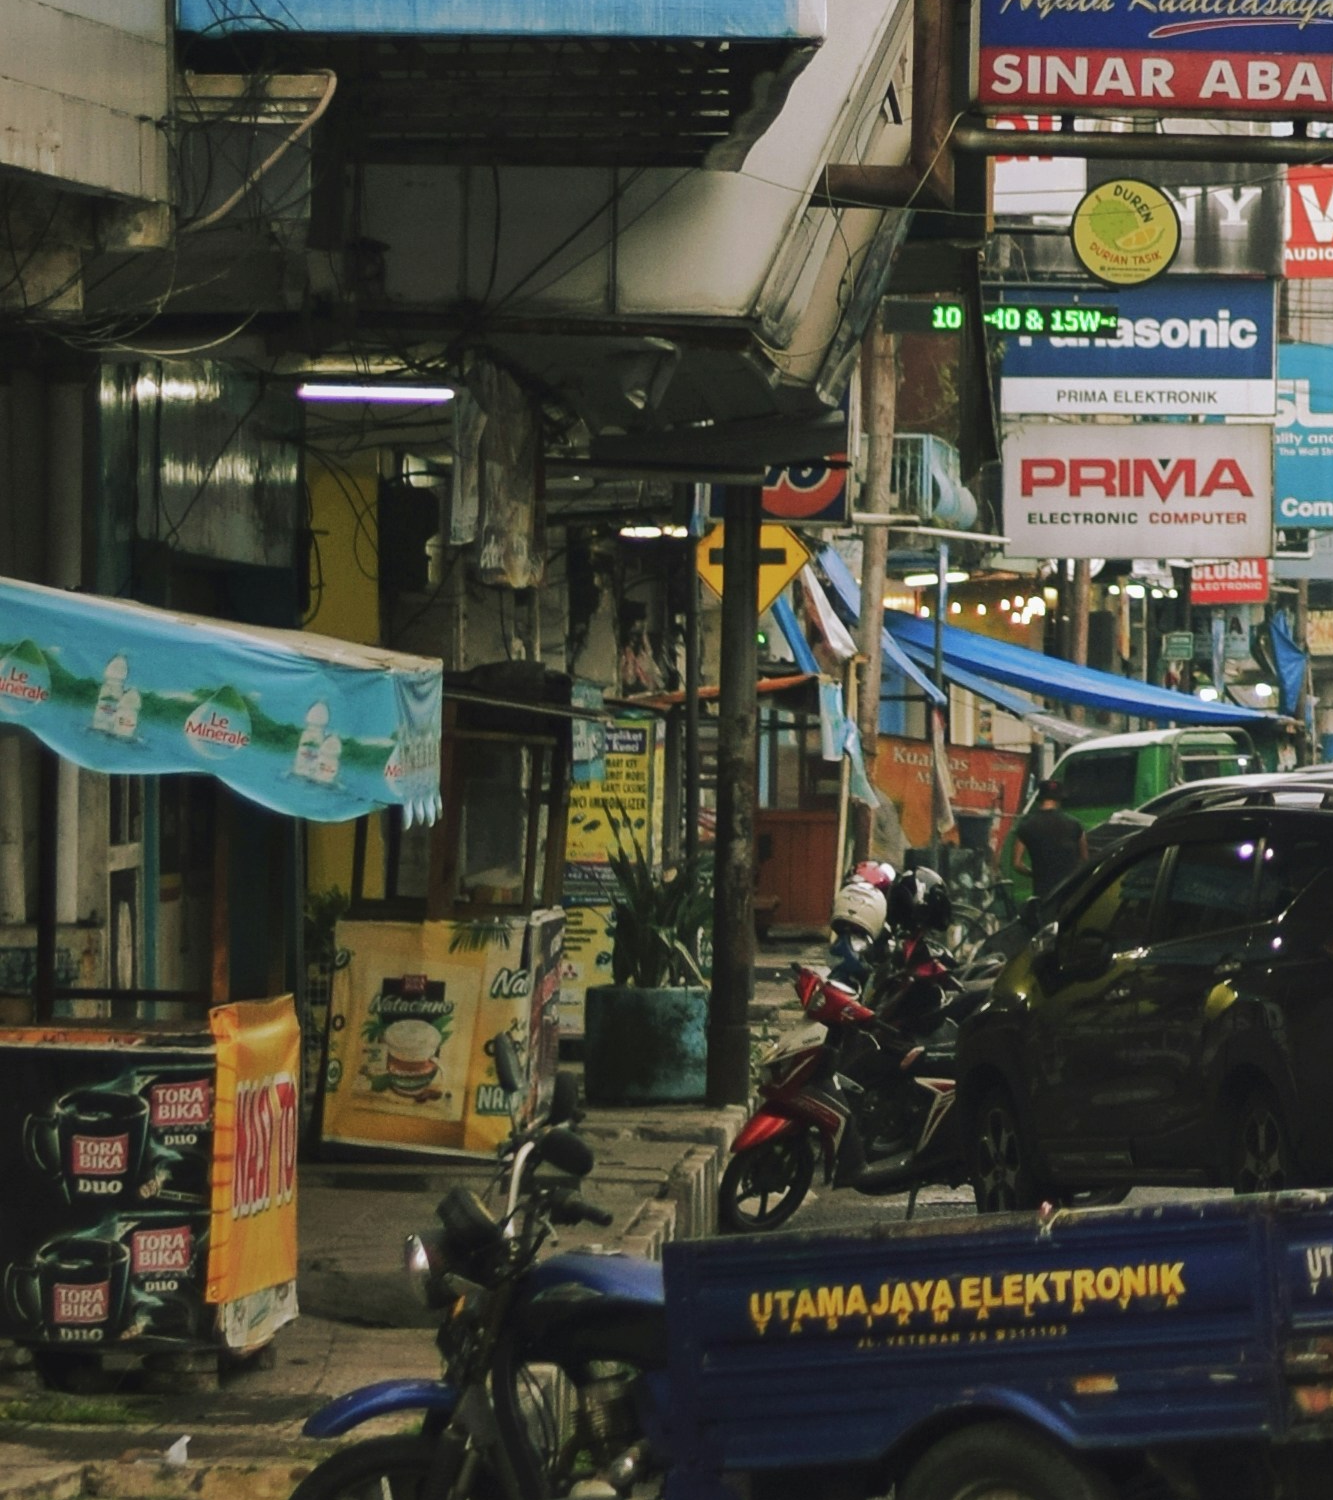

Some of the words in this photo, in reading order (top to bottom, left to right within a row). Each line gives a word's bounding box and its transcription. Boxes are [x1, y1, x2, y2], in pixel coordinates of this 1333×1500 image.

[990, 54, 1175, 98] SINAR
[1113, 183, 1154, 223] DUREN
[1056, 389, 1108, 404] PRIMA
[1113, 389, 1218, 404] ELEKTRONIK
[1020, 458, 1254, 504] PRIMA
[1028, 512, 1139, 525] ELECTRONIC
[1149, 511, 1247, 525] COMPUTER
[1191, 581, 1262, 592] ELECTRONIC
[10, 666, 28, 684] Le
[211, 711, 229, 730] Le
[185, 720, 251, 747] Minerale
[156, 1086, 204, 1104] TORA
[157, 1103, 204, 1120] BIKA
[77, 1139, 124, 1156] TORA
[164, 1134, 198, 1147] DUO
[78, 1154, 122, 1170] BIKA
[78, 1179, 123, 1195] DUO
[136, 1234, 185, 1251] TORA
[138, 1249, 184, 1266] BIKA
[58, 1287, 105, 1303] TORA
[748, 1282, 869, 1325] UTAMA
[870, 1278, 956, 1316] JAYA
[959, 1261, 1186, 1311] ELEKTRONIK
[60, 1301, 104, 1317] BIKA
